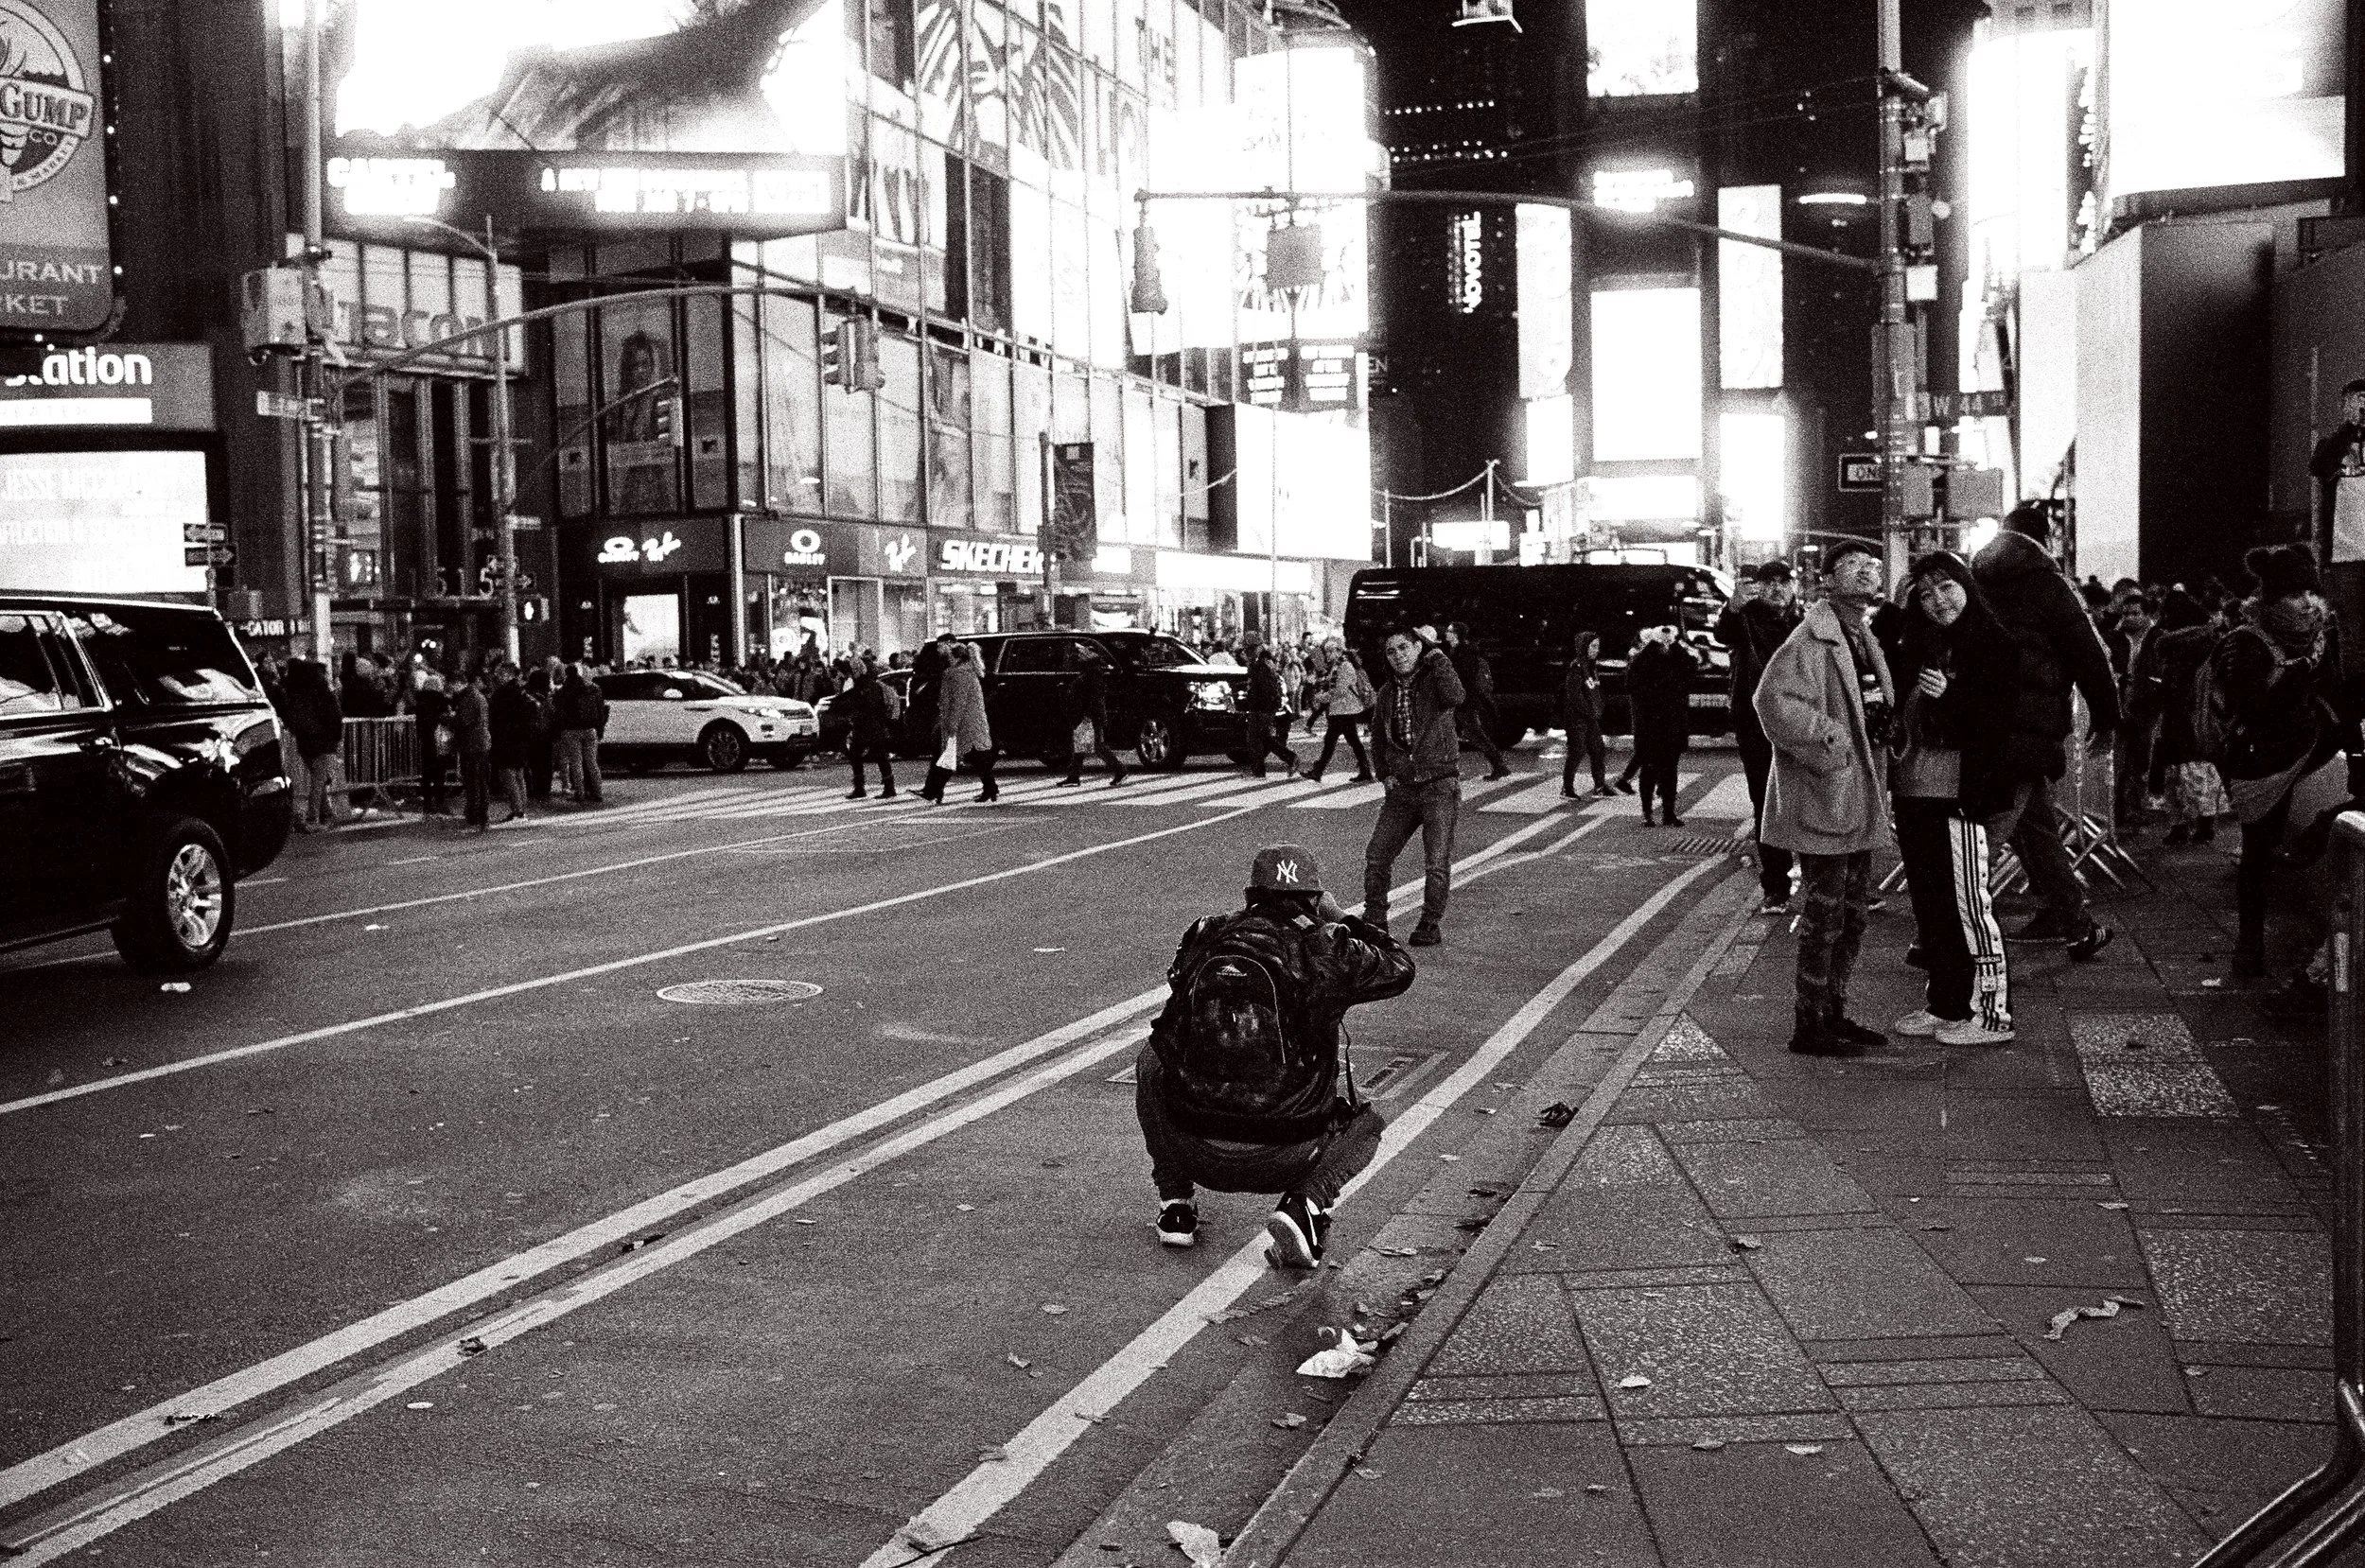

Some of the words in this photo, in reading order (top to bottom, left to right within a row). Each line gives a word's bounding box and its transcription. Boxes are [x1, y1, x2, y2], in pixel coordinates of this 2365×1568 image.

[1, 81, 89, 129] GUMP
[1462, 211, 1482, 313] NOVOTEL
[5, 345, 152, 386] ation
[1934, 395, 1951, 417] W
[1959, 393, 1983, 416] 44
[941, 539, 1057, 574] SKECHER
[1276, 860, 1299, 883] NY
